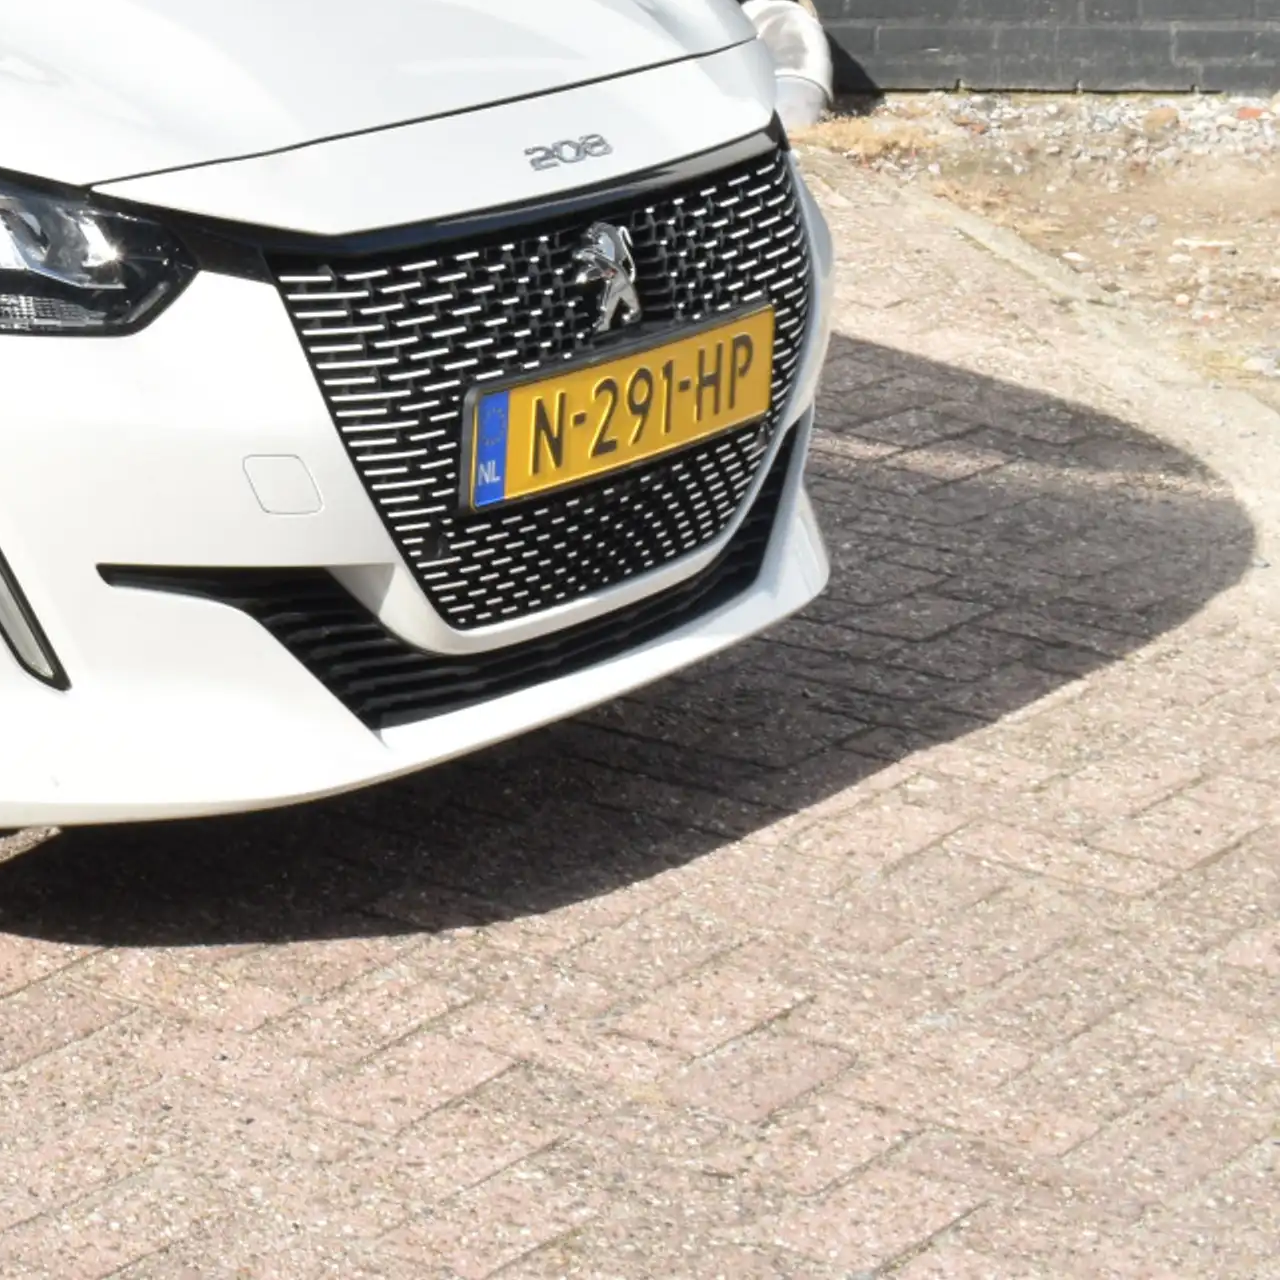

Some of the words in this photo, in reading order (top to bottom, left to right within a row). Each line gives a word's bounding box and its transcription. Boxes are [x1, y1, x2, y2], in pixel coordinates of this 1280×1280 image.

[524, 133, 613, 171] 208
[528, 332, 754, 478] N-291-HP
[477, 460, 501, 486] NL
